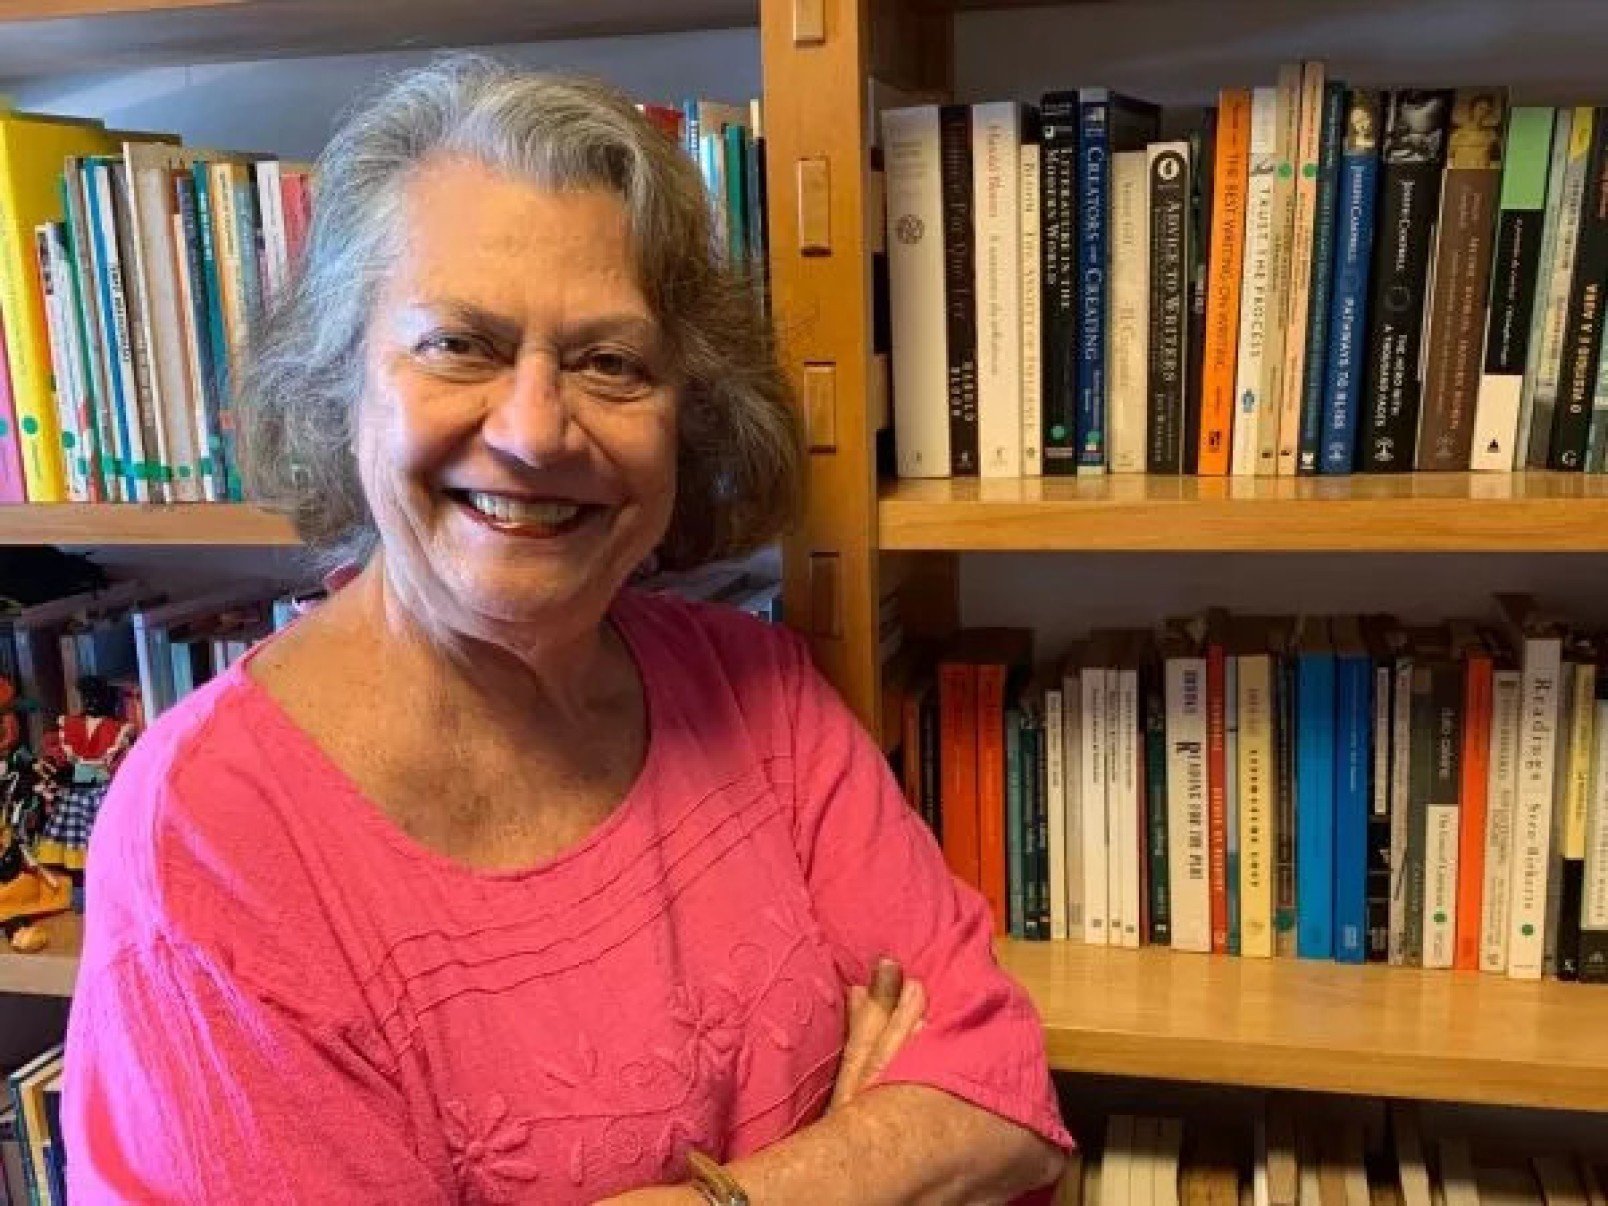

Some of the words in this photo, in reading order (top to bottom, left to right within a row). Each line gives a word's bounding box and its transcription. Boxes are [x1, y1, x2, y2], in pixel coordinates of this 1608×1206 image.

[1046, 148, 1060, 220] MODERN
[1060, 147, 1073, 247] LITERATURE
[1083, 146, 1104, 241] CREATORS
[1223, 184, 1238, 216] BEST
[1046, 222, 1060, 286] WORLD
[1166, 199, 1181, 266] ADVICE
[1084, 267, 1103, 361] CREATING
[1164, 294, 1181, 382] WRITERS
[1338, 297, 1356, 365] PATHWAYS
[1333, 392, 1349, 430] BLISS
[1525, 679, 1553, 781] Readings
